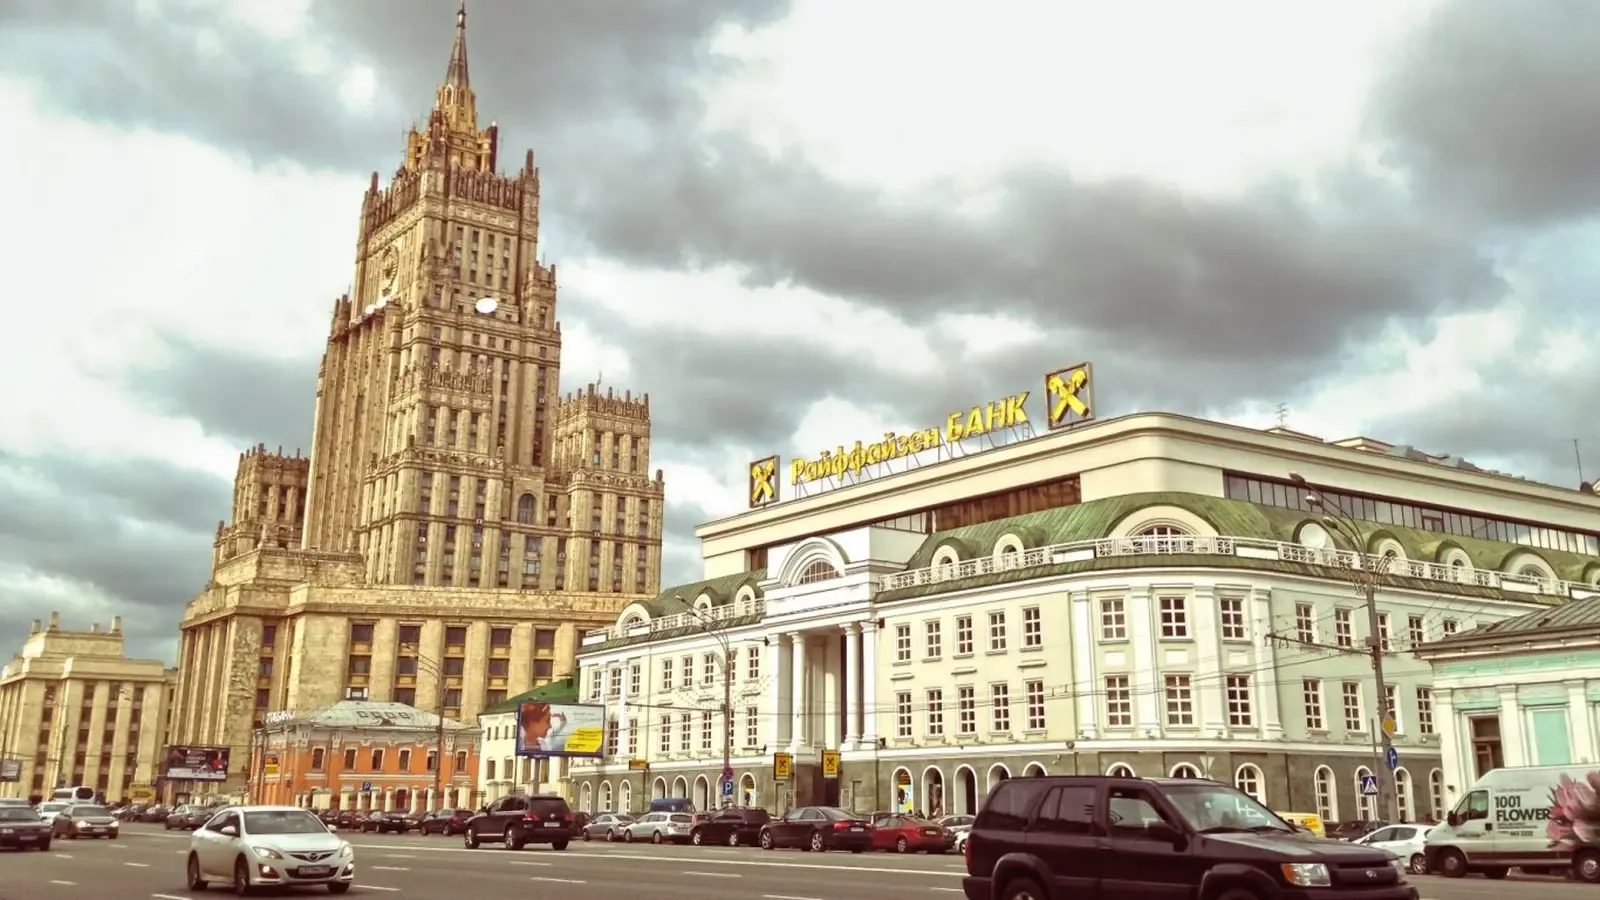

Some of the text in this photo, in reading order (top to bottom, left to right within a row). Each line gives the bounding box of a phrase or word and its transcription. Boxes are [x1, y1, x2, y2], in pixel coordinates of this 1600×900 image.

[792, 391, 1030, 485] Райффайзен БАНК
[725, 782, 732, 794] P
[1494, 795, 1521, 808] 1001
